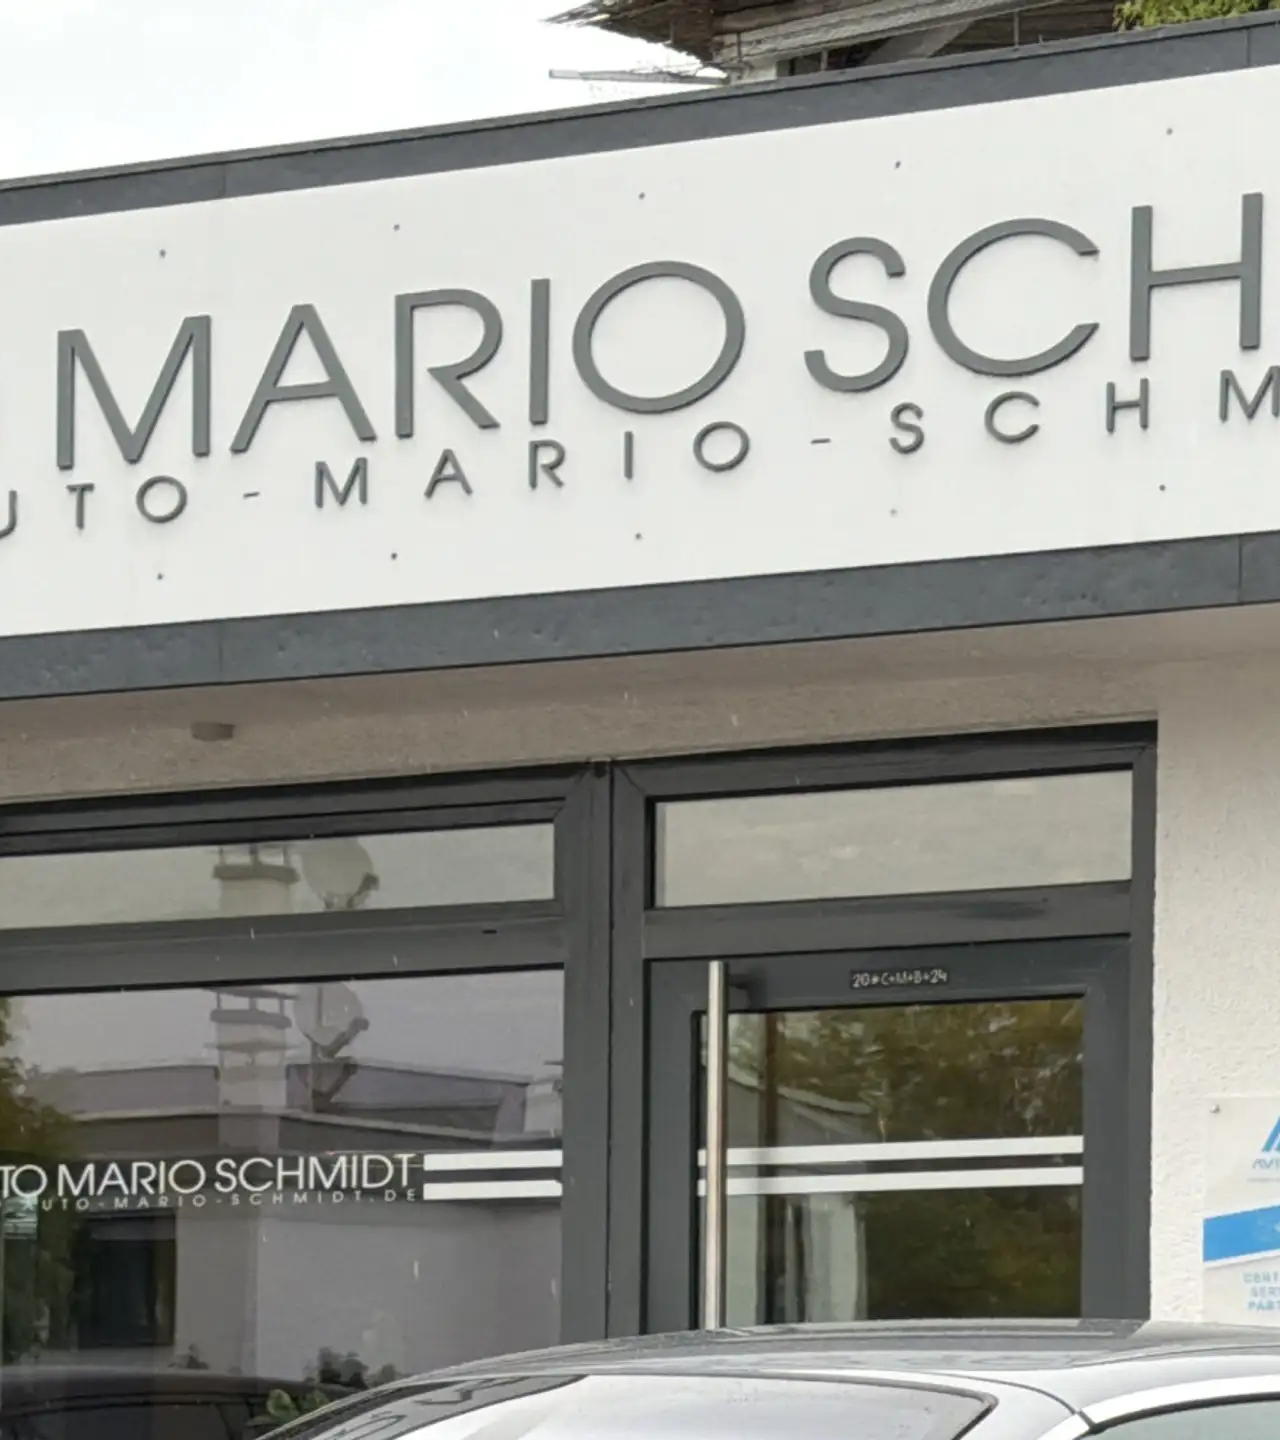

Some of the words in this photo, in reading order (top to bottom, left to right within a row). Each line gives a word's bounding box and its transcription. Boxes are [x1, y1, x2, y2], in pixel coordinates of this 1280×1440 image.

[56, 259, 746, 470] MARIO
[57, 1159, 207, 1199] MARIO
[213, 1152, 418, 1194] SCHMIDT
